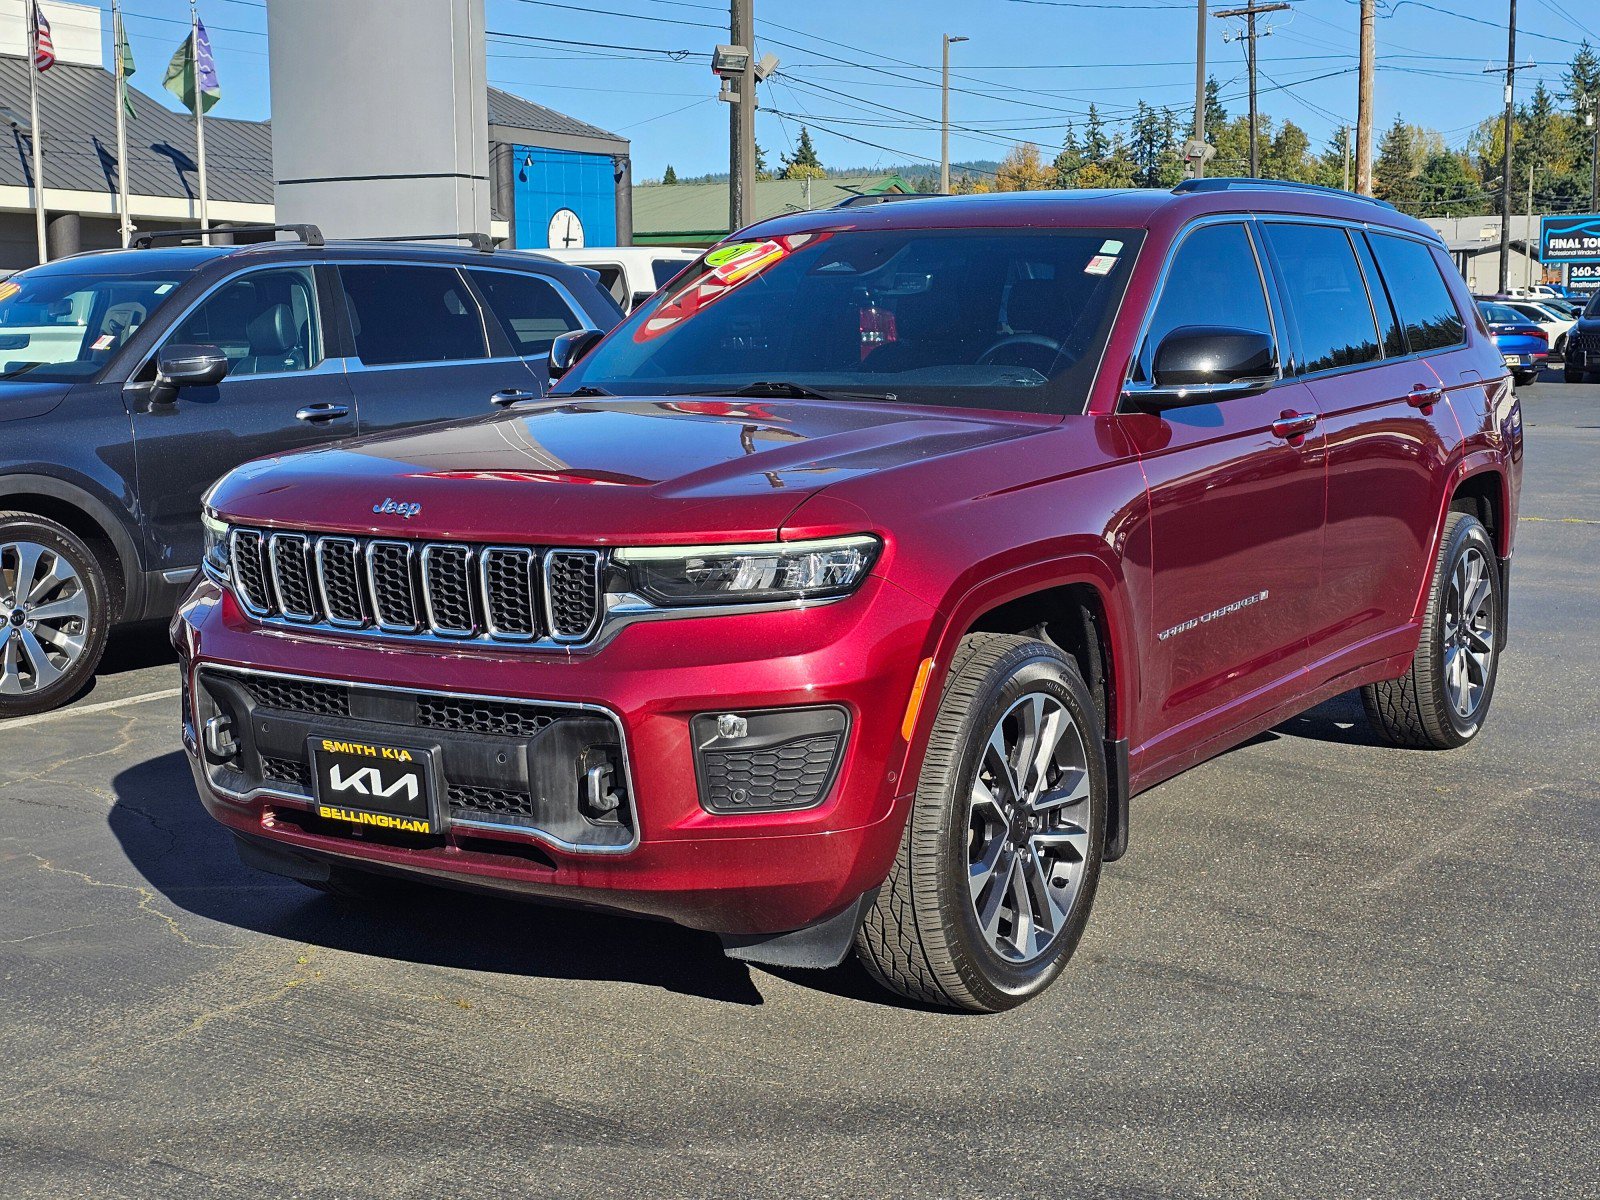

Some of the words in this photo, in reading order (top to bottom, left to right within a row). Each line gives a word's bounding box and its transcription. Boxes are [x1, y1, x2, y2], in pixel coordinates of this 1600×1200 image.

[1549, 238, 1581, 249] FINAL
[1570, 266, 1600, 277] 360-3
[372, 497, 421, 519] Jeep
[1158, 617, 1199, 641] GRAND
[1200, 594, 1260, 624] CHEROKEE
[322, 740, 377, 757] SMITH
[381, 747, 413, 761] KIA
[329, 763, 419, 801] KIA
[319, 806, 430, 834] BELLINGHAM
